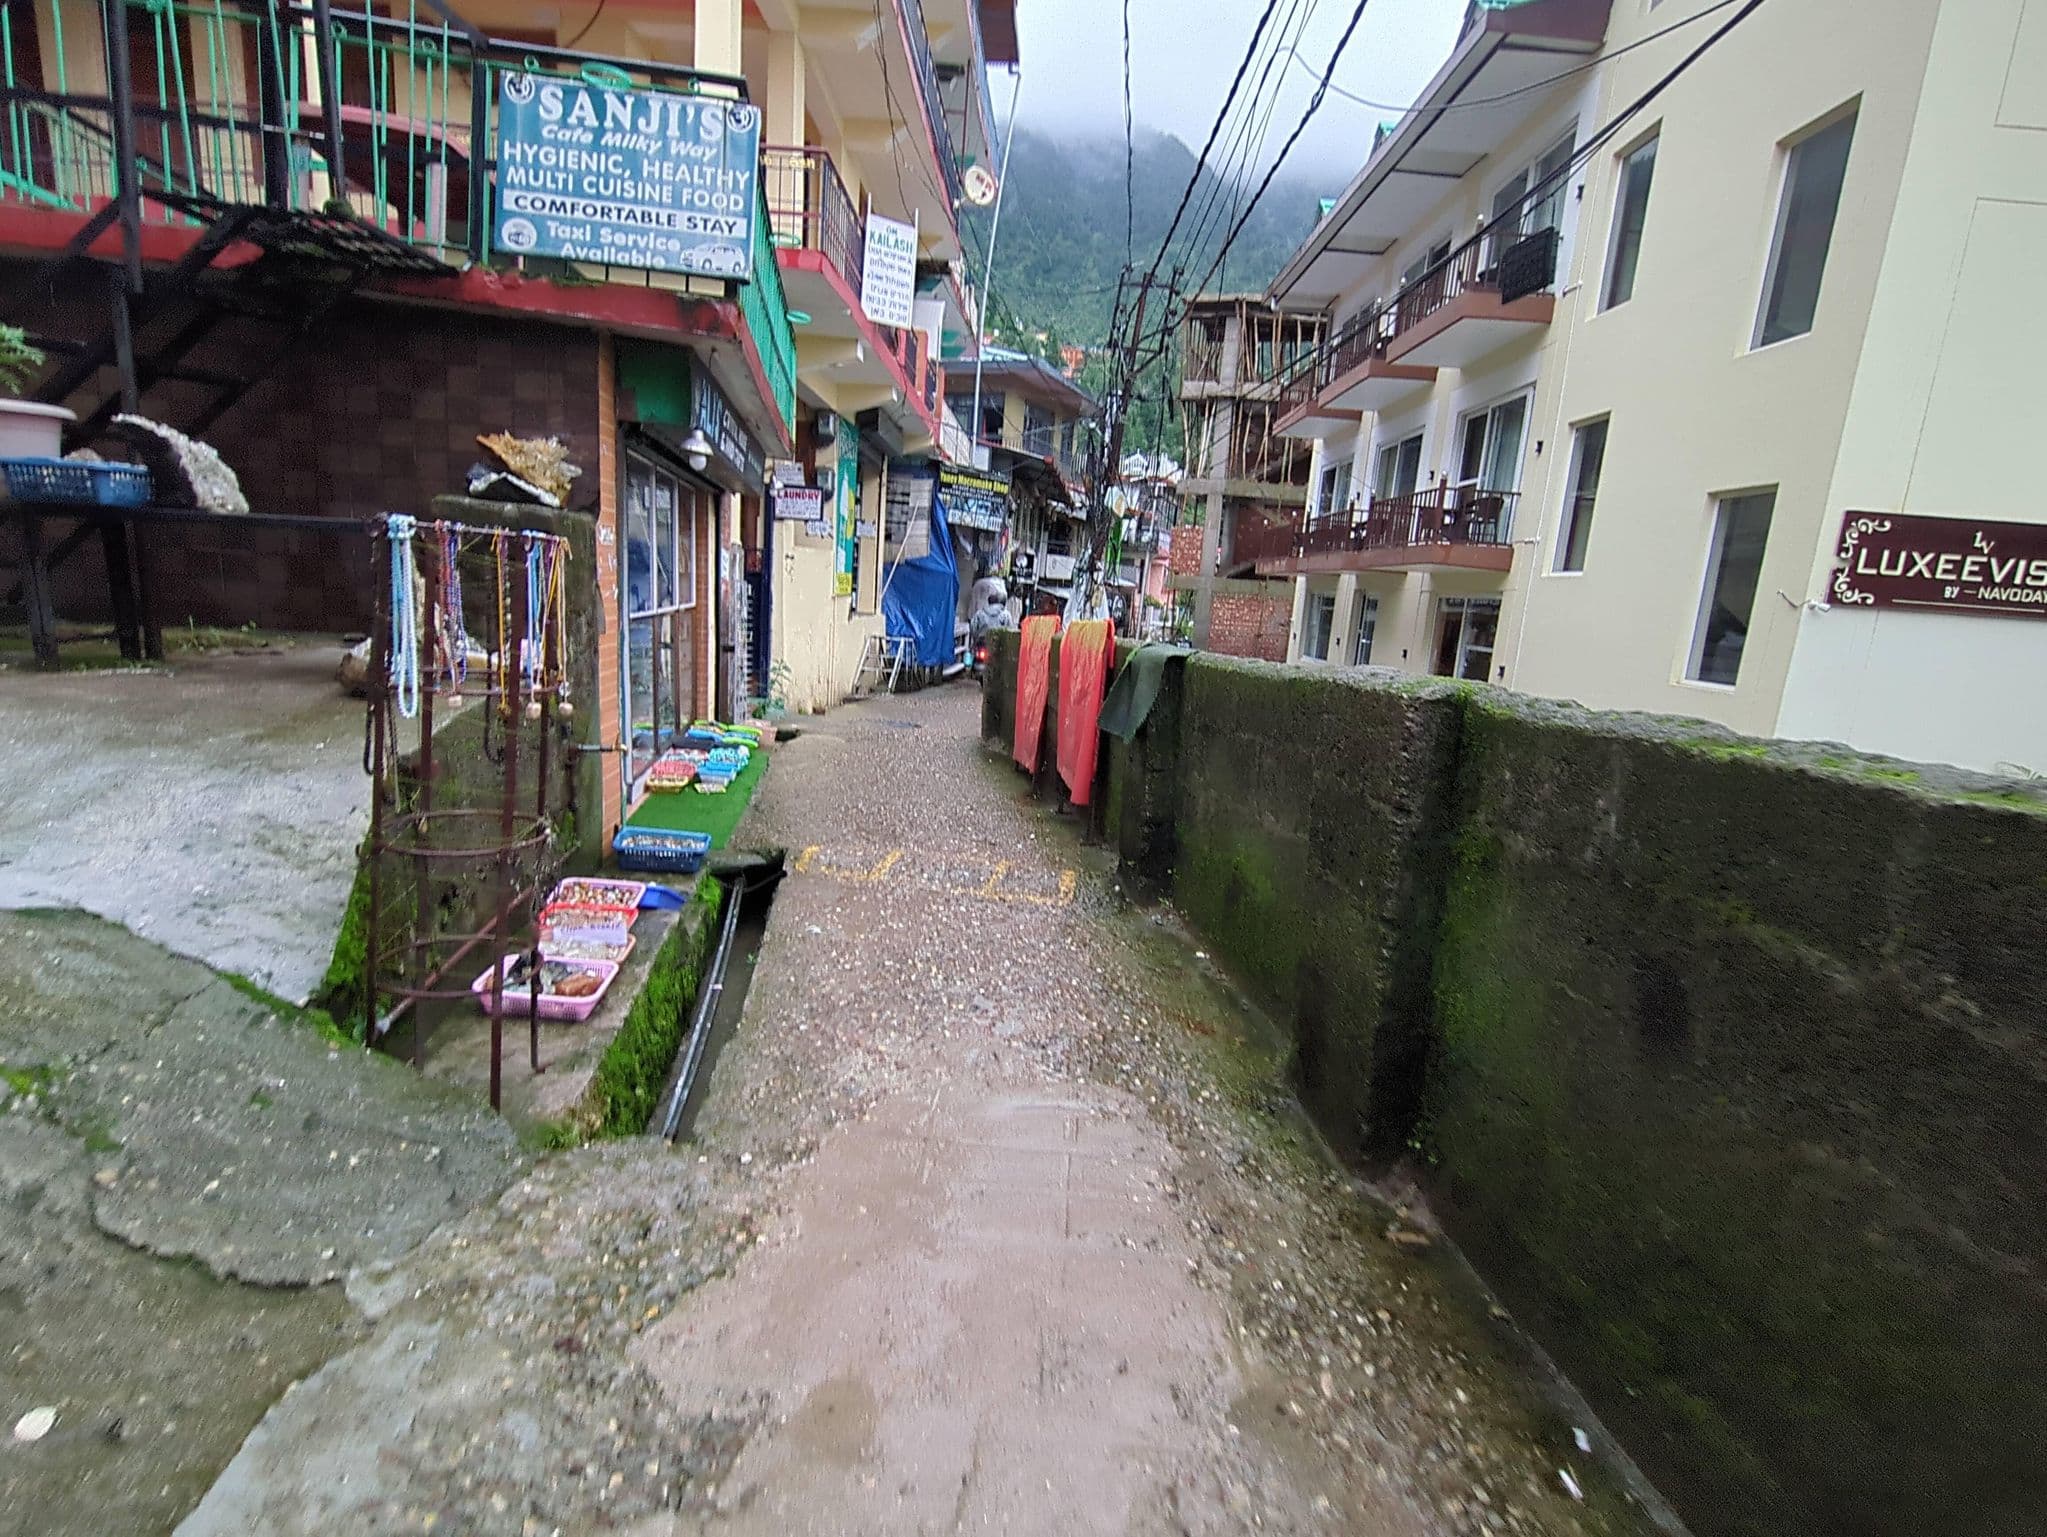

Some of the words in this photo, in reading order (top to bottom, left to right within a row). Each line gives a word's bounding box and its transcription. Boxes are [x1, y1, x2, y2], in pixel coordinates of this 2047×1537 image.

[538, 85, 724, 140] SANJI'S
[600, 131, 662, 155] Milky
[670, 140, 718, 161] Way
[504, 140, 631, 179] HYGIENIC,
[642, 159, 750, 191] HEALTHY
[506, 166, 574, 192] MULTI
[583, 175, 673, 204] CUISINE
[682, 189, 745, 211] FOOD
[514, 195, 677, 227] COMFORTABLE
[686, 215, 738, 236] STAY
[546, 221, 591, 242] Taxi
[600, 227, 681, 251] Service
[560, 242, 667, 266] Available
[777, 489, 820, 500] LAUNDRY
[1944, 586, 1960, 599] BY
